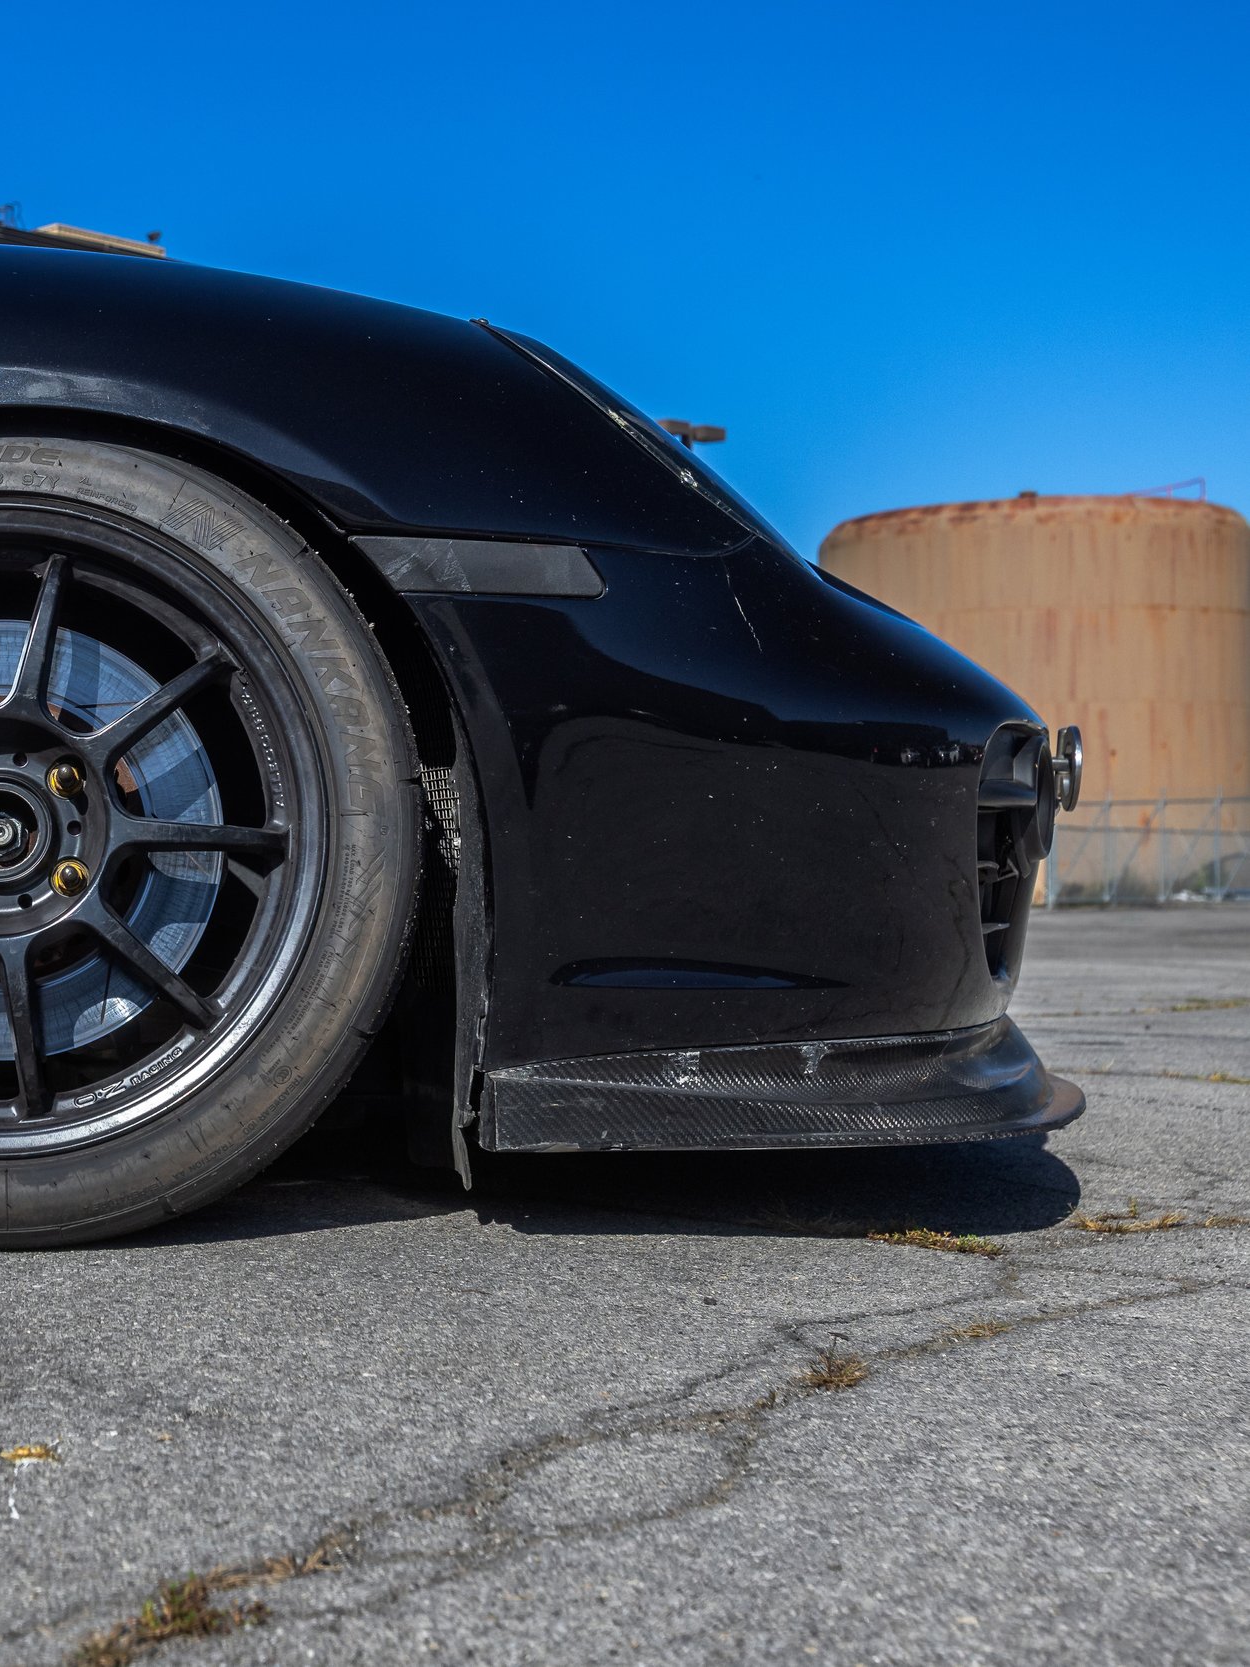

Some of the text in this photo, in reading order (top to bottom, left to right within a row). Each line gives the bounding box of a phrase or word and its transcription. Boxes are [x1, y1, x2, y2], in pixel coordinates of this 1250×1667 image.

[22, 473, 59, 488] 97Y
[231, 551, 386, 813] NANKANG
[129, 1045, 183, 1086] RACING
[258, 1073, 303, 1122] TREADWEAR
[242, 1119, 258, 1135] 100
[189, 1139, 234, 1172] TRACTION
[94, 1180, 165, 1211] TEMPERATURE
